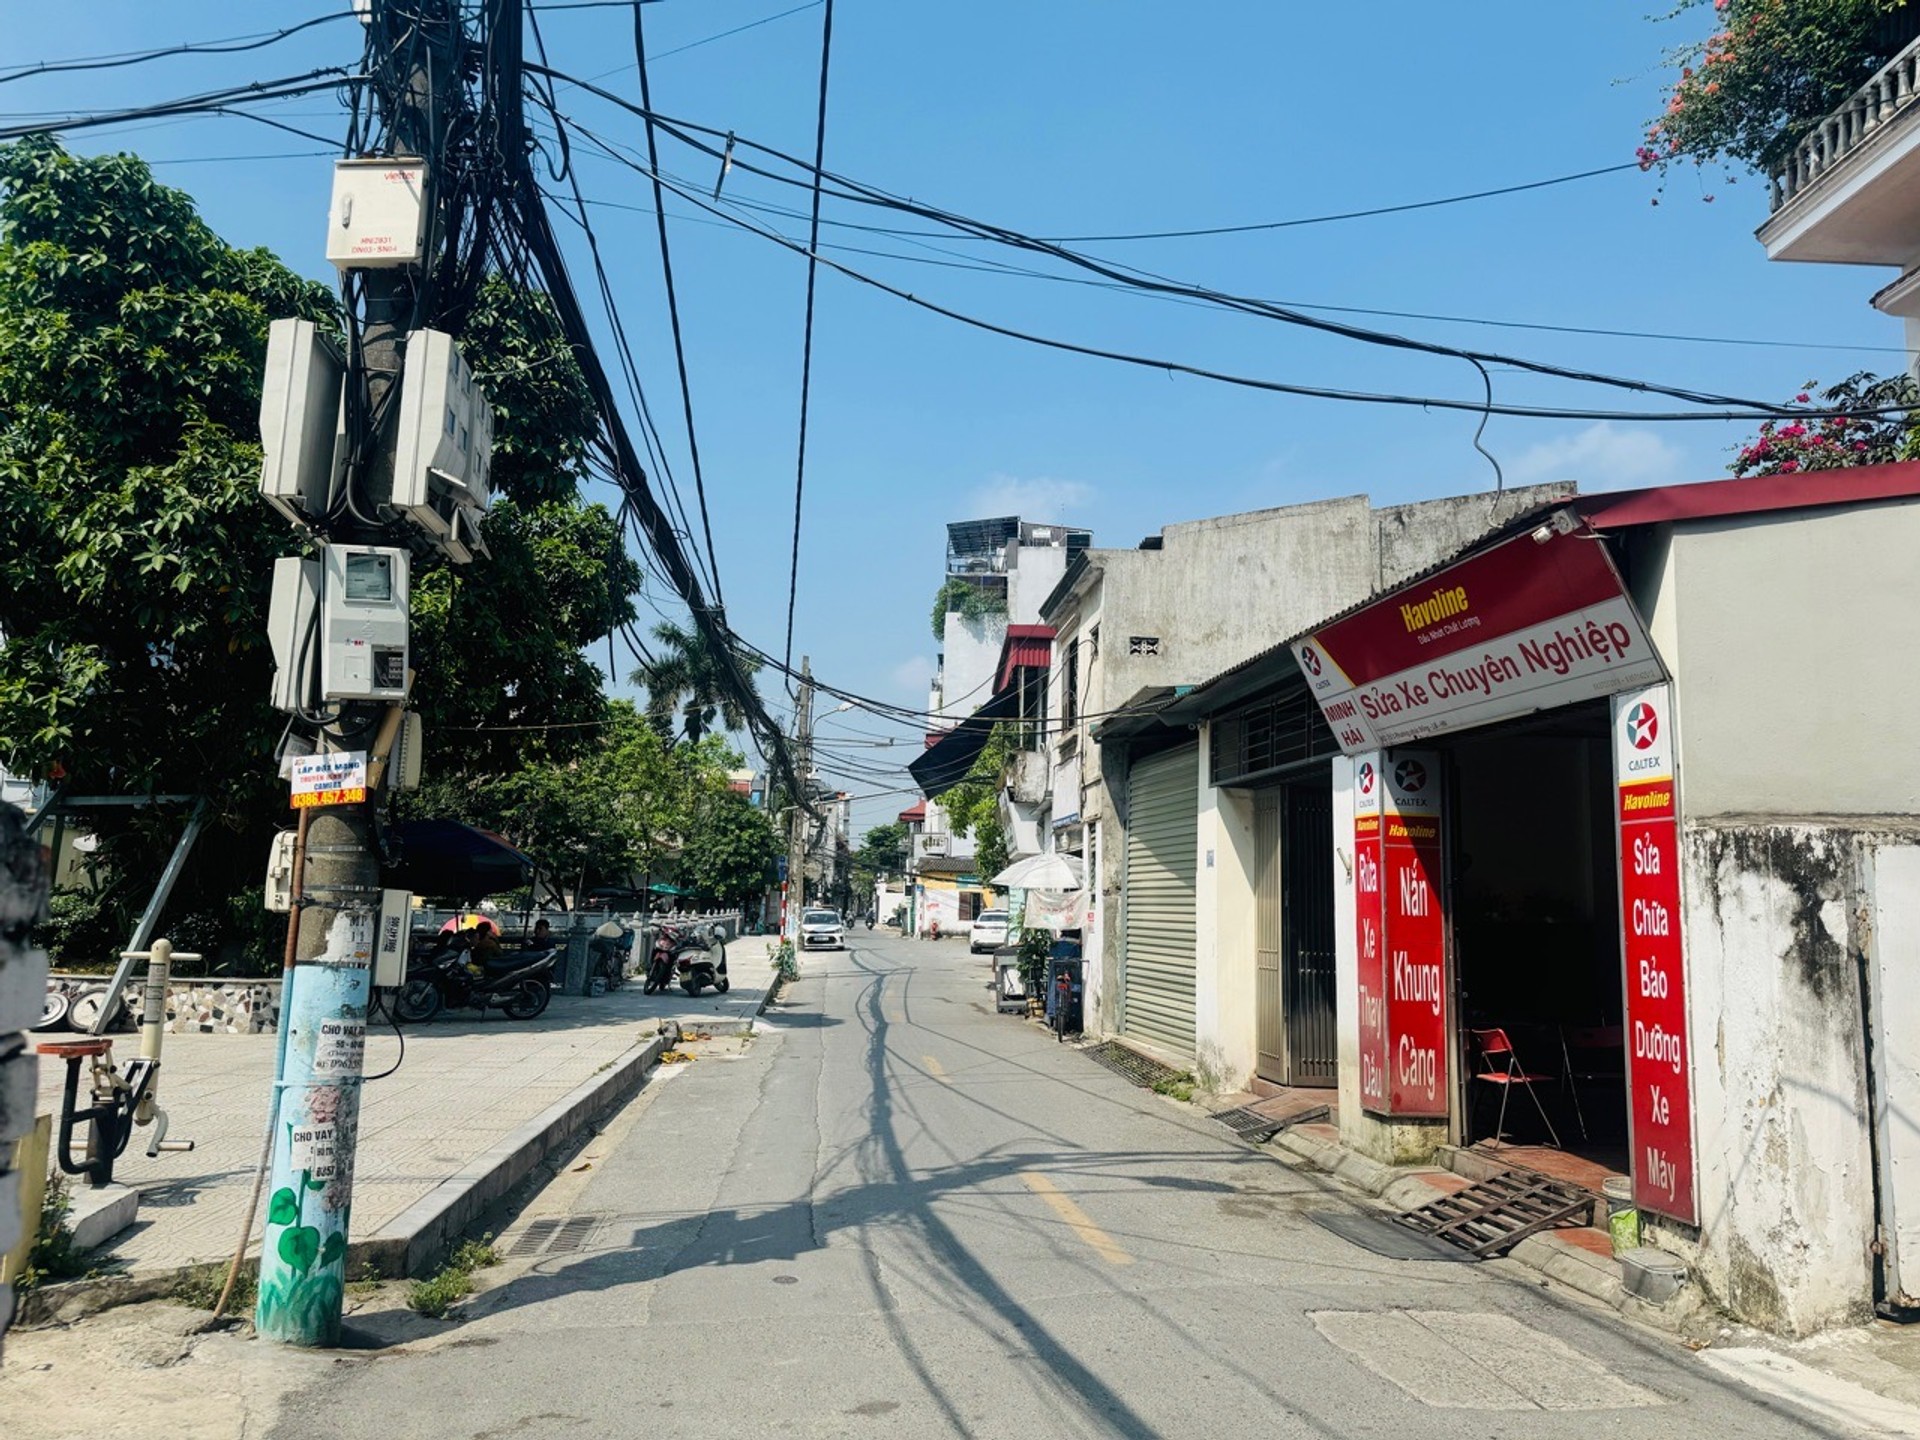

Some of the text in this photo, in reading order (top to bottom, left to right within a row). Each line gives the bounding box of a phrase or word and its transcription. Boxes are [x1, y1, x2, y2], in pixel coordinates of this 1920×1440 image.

[1400, 585, 1469, 634] Havoline
[1360, 619, 1632, 720] Sửa Xe Chuyên Nghiệp
[1324, 700, 1357, 723] MINH
[1341, 723, 1365, 746] HẢI
[1628, 756, 1661, 771] CALTEX
[1395, 797, 1428, 807] CALTEX
[1624, 791, 1670, 811] Havoline
[1388, 824, 1436, 838] Havoline
[1634, 832, 1661, 876] Sửa
[1399, 857, 1429, 917] Nắn
[1362, 918, 1376, 959] Xe
[1632, 899, 1670, 937] Chữa
[1393, 950, 1441, 1017] Khung
[1639, 956, 1669, 1000] Bảo
[321, 1024, 342, 1035] CHO
[1359, 989, 1382, 1039] Thay
[1398, 1033, 1436, 1102] Càng
[1635, 1021, 1682, 1074] Dưỡng
[1650, 1084, 1670, 1126] Xe
[294, 1129, 333, 1142] CHO VAY
[1646, 1146, 1677, 1203] Máy
